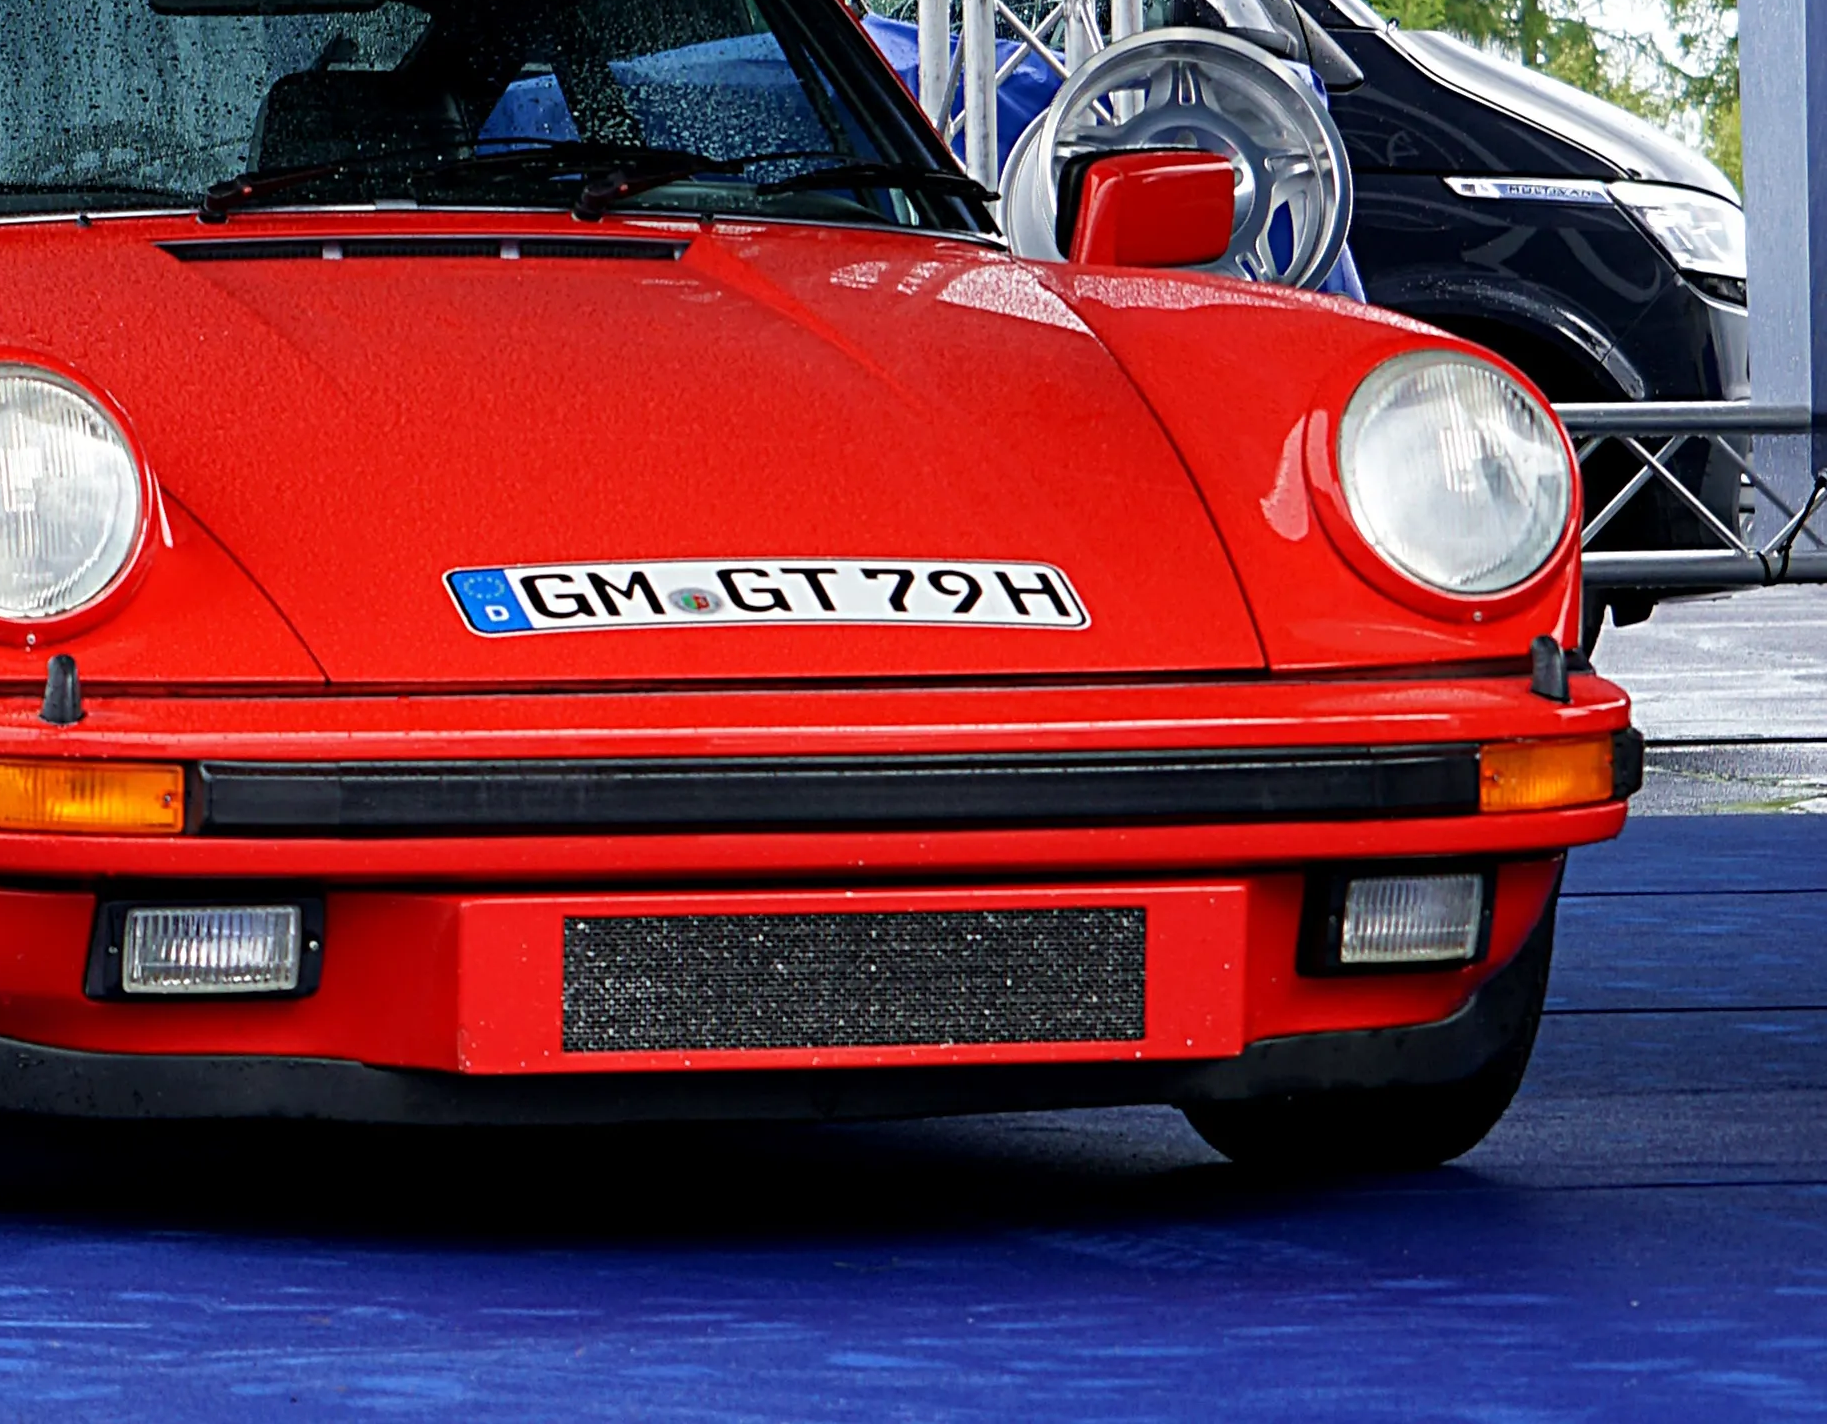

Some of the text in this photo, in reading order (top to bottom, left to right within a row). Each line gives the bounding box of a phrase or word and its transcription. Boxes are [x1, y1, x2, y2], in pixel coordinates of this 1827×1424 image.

[1508, 184, 1592, 198] MULTIVAN
[519, 567, 1071, 621] GM GT 79H
[488, 605, 510, 623] D
